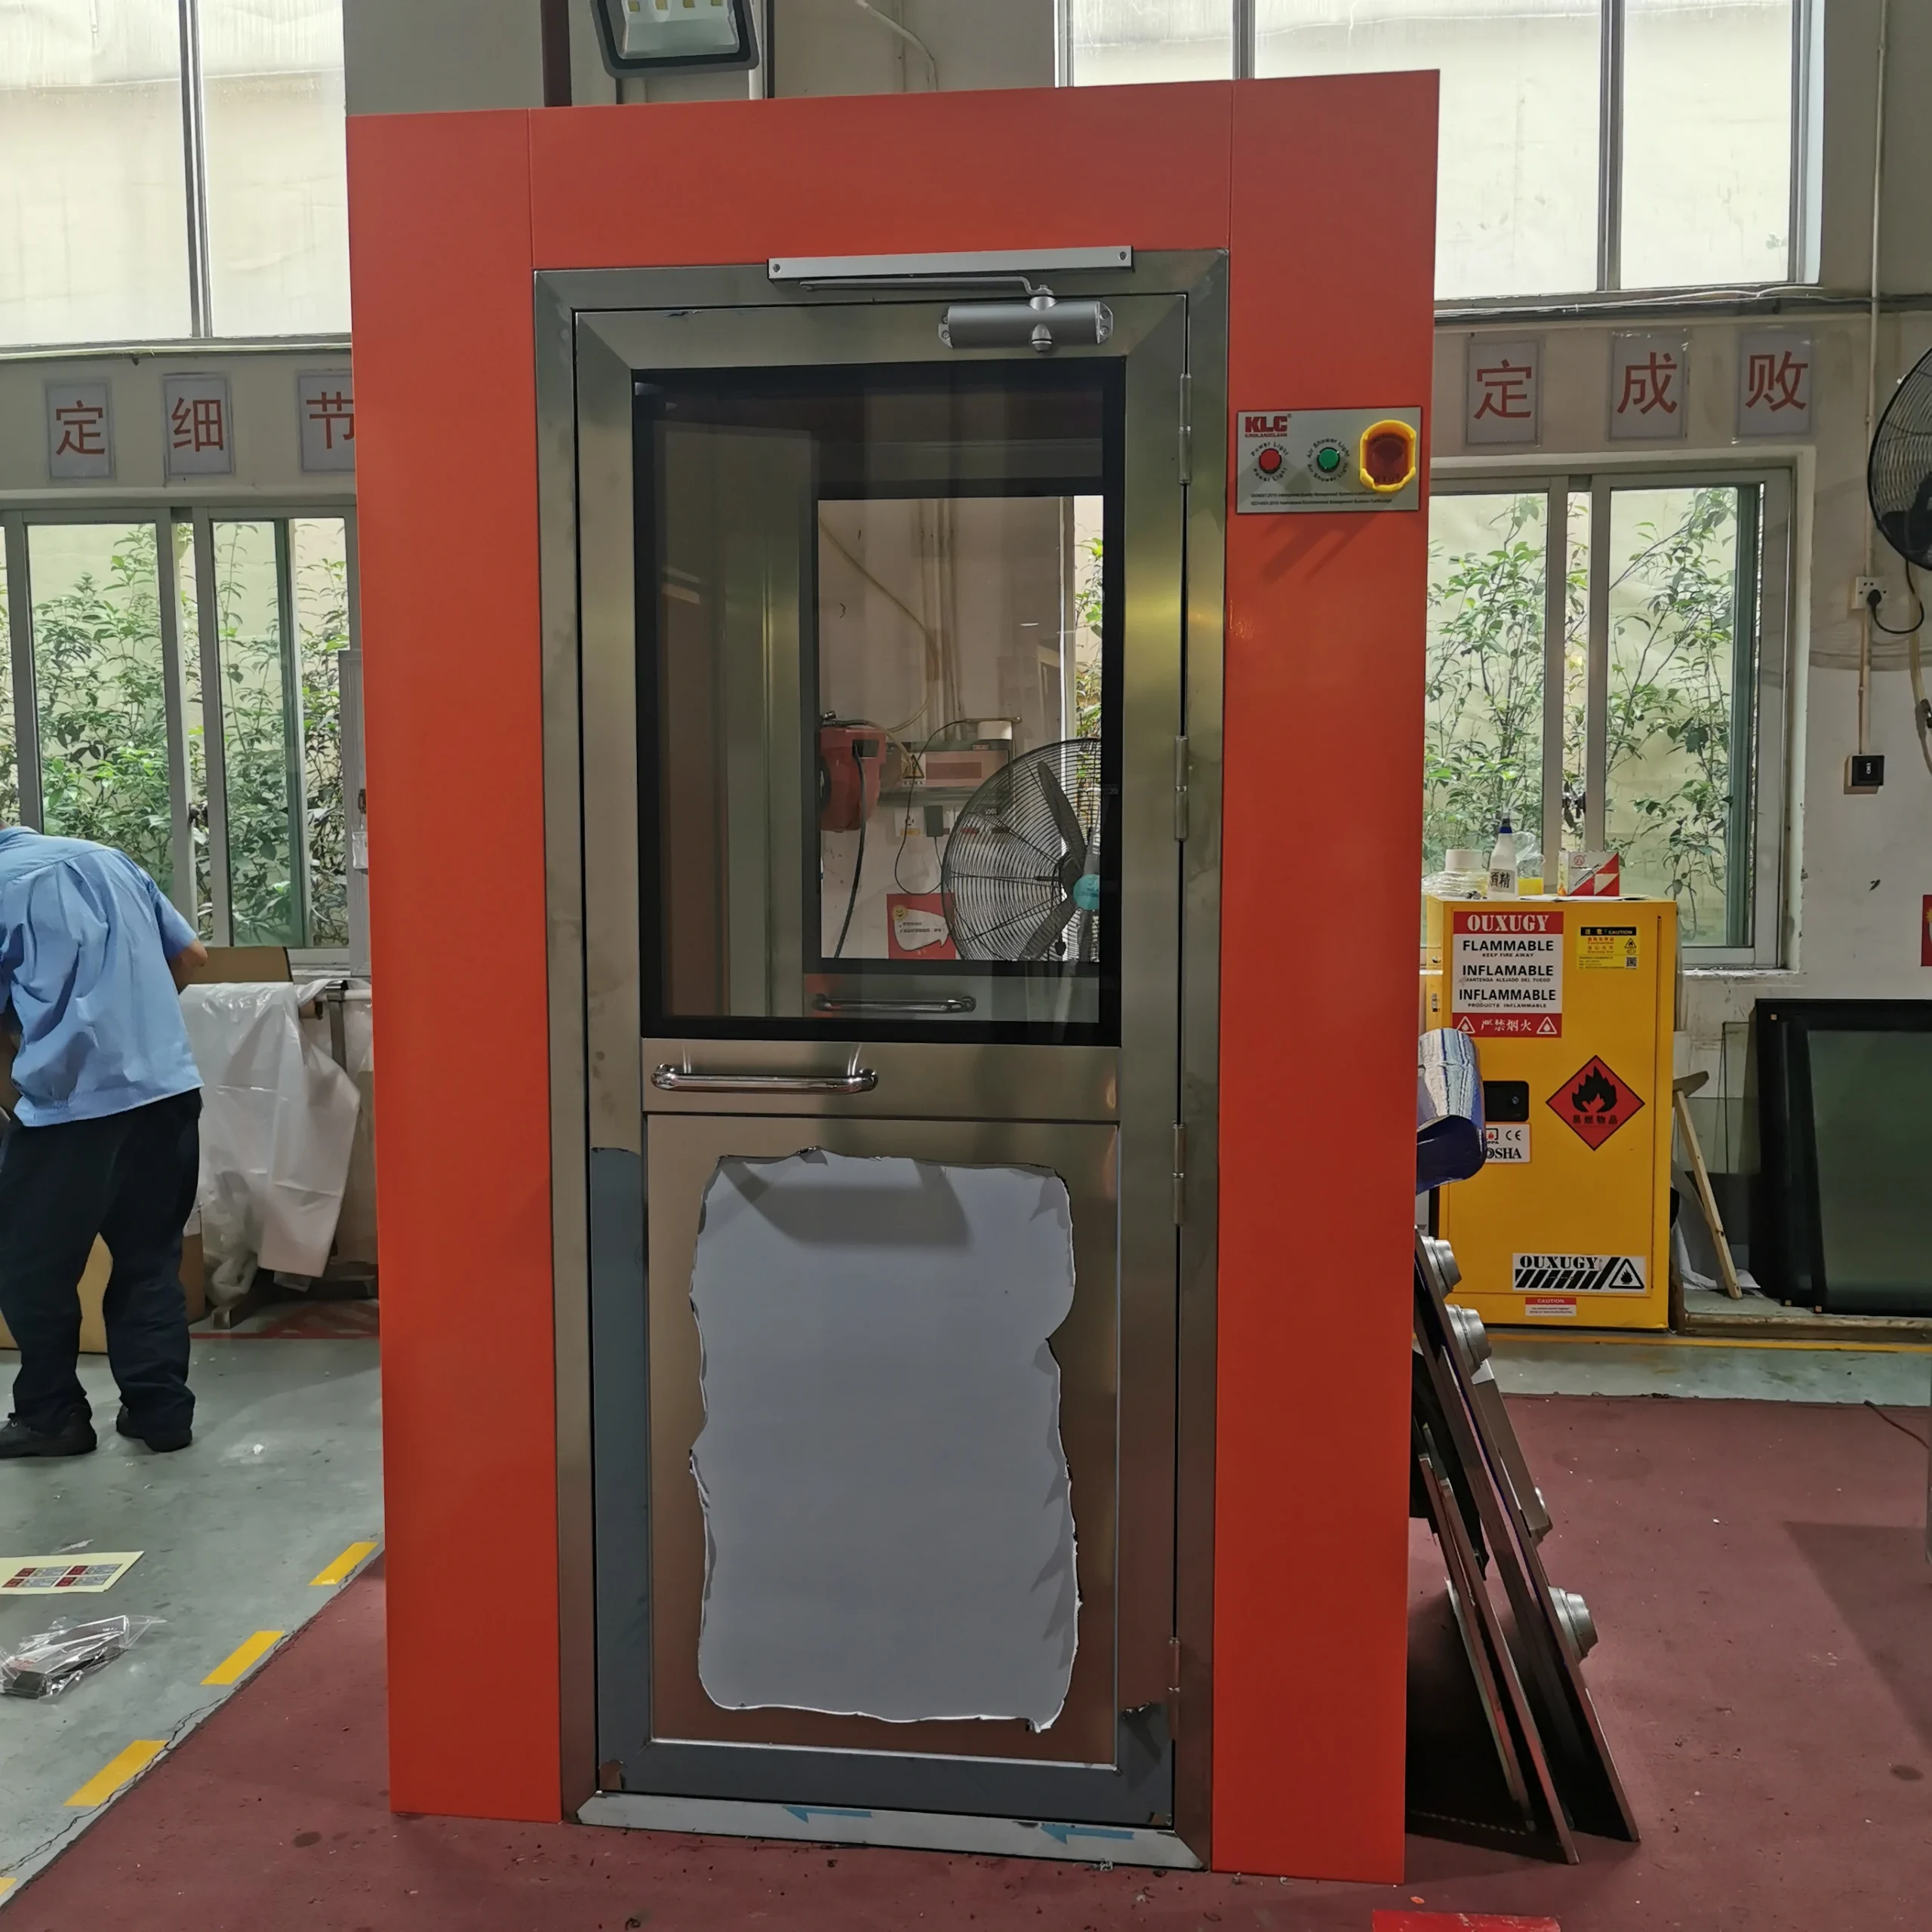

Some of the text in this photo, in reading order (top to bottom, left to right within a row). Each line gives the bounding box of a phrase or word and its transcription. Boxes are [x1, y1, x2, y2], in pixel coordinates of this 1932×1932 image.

[1473, 350, 1809, 420] 定 成 败
[55, 392, 354, 455] 定 细 节
[1245, 416, 1287, 432] KLC
[1251, 441, 1290, 457] Power Light
[1313, 438, 1337, 449] Shower
[1467, 914, 1549, 932] OUXUGY
[1463, 940, 1554, 951] FLAMMABLE
[1463, 965, 1554, 976] INFLAMABLE
[1459, 989, 1556, 1001] INFLAMMABLE
[1481, 1019, 1532, 1032] 严禁烟火
[1506, 1130, 1521, 1141] CE
[1486, 1147, 1521, 1159] OSHA
[1519, 1255, 1598, 1269] OUXUGY
